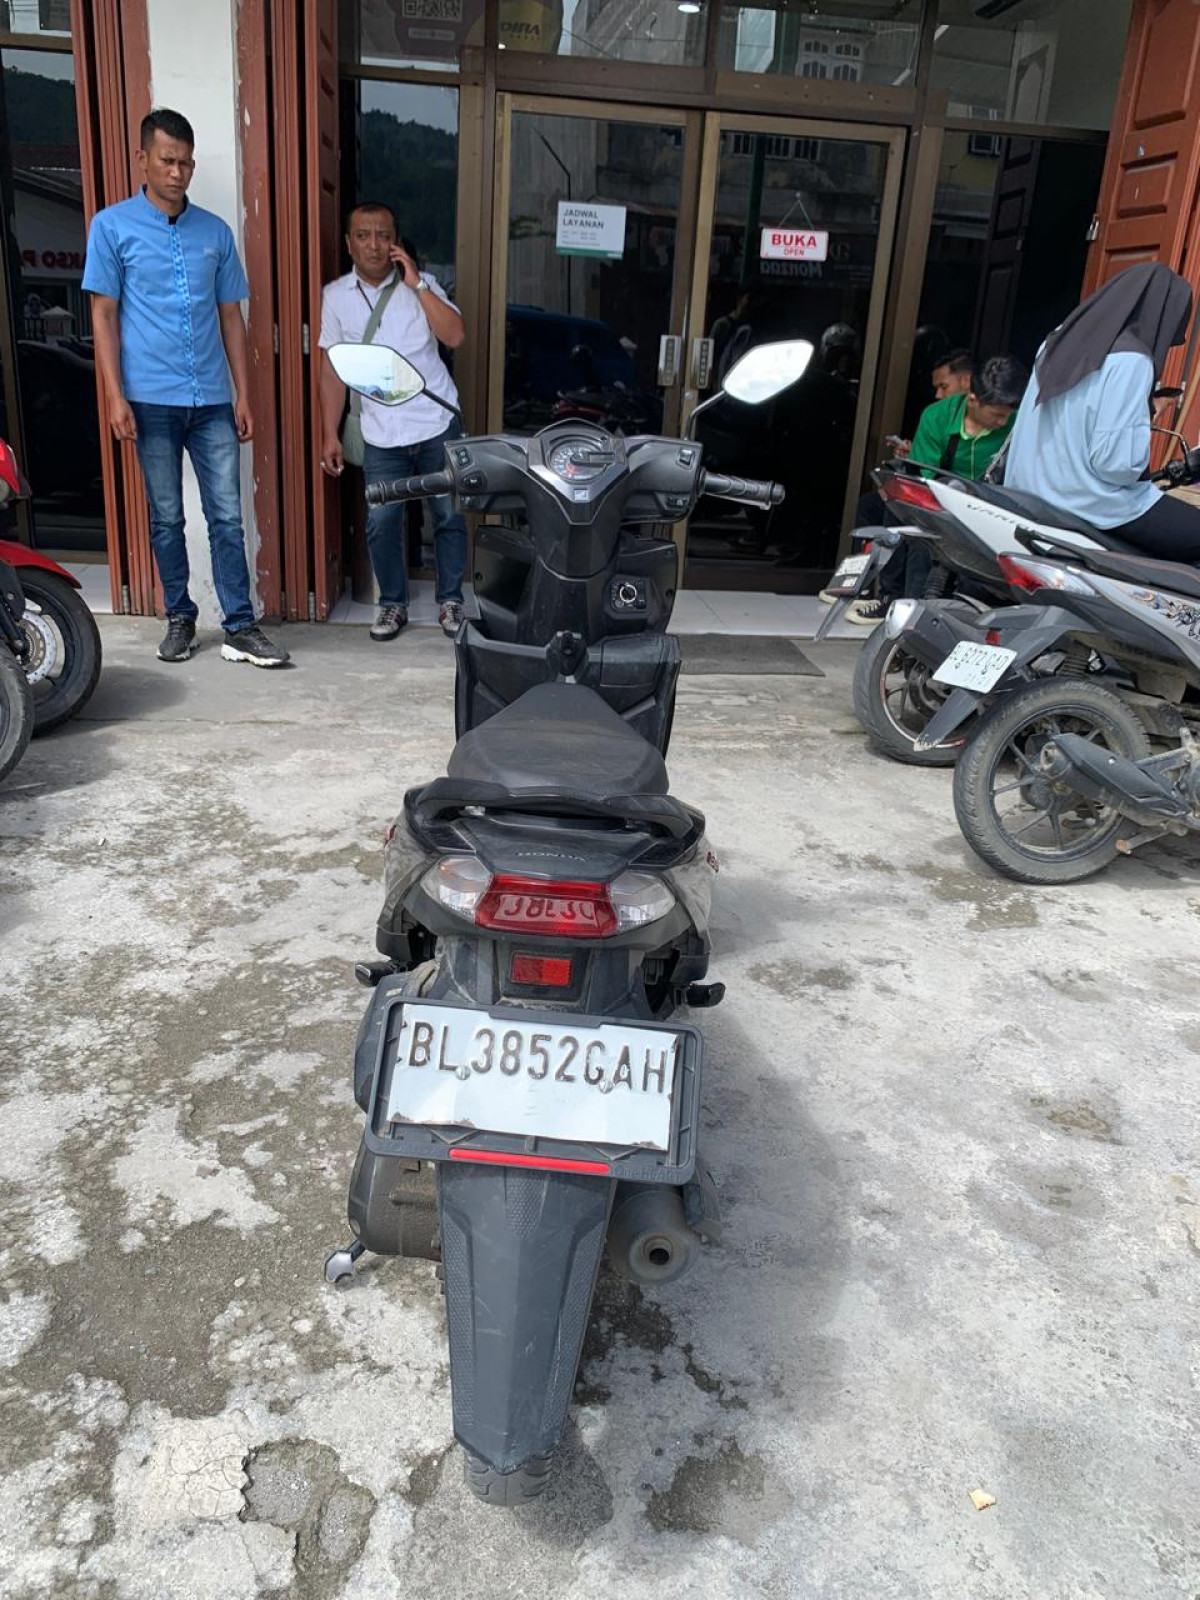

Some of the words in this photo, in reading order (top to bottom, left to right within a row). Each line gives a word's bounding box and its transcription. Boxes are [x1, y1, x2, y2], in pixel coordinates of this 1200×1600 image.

[563, 209, 600, 219] JADWAL
[563, 218, 605, 229] LAYANAN
[771, 233, 817, 248] BUKA
[783, 248, 805, 256] OPEN
[408, 1020, 458, 1072] BL
[470, 1028, 580, 1082] 3852
